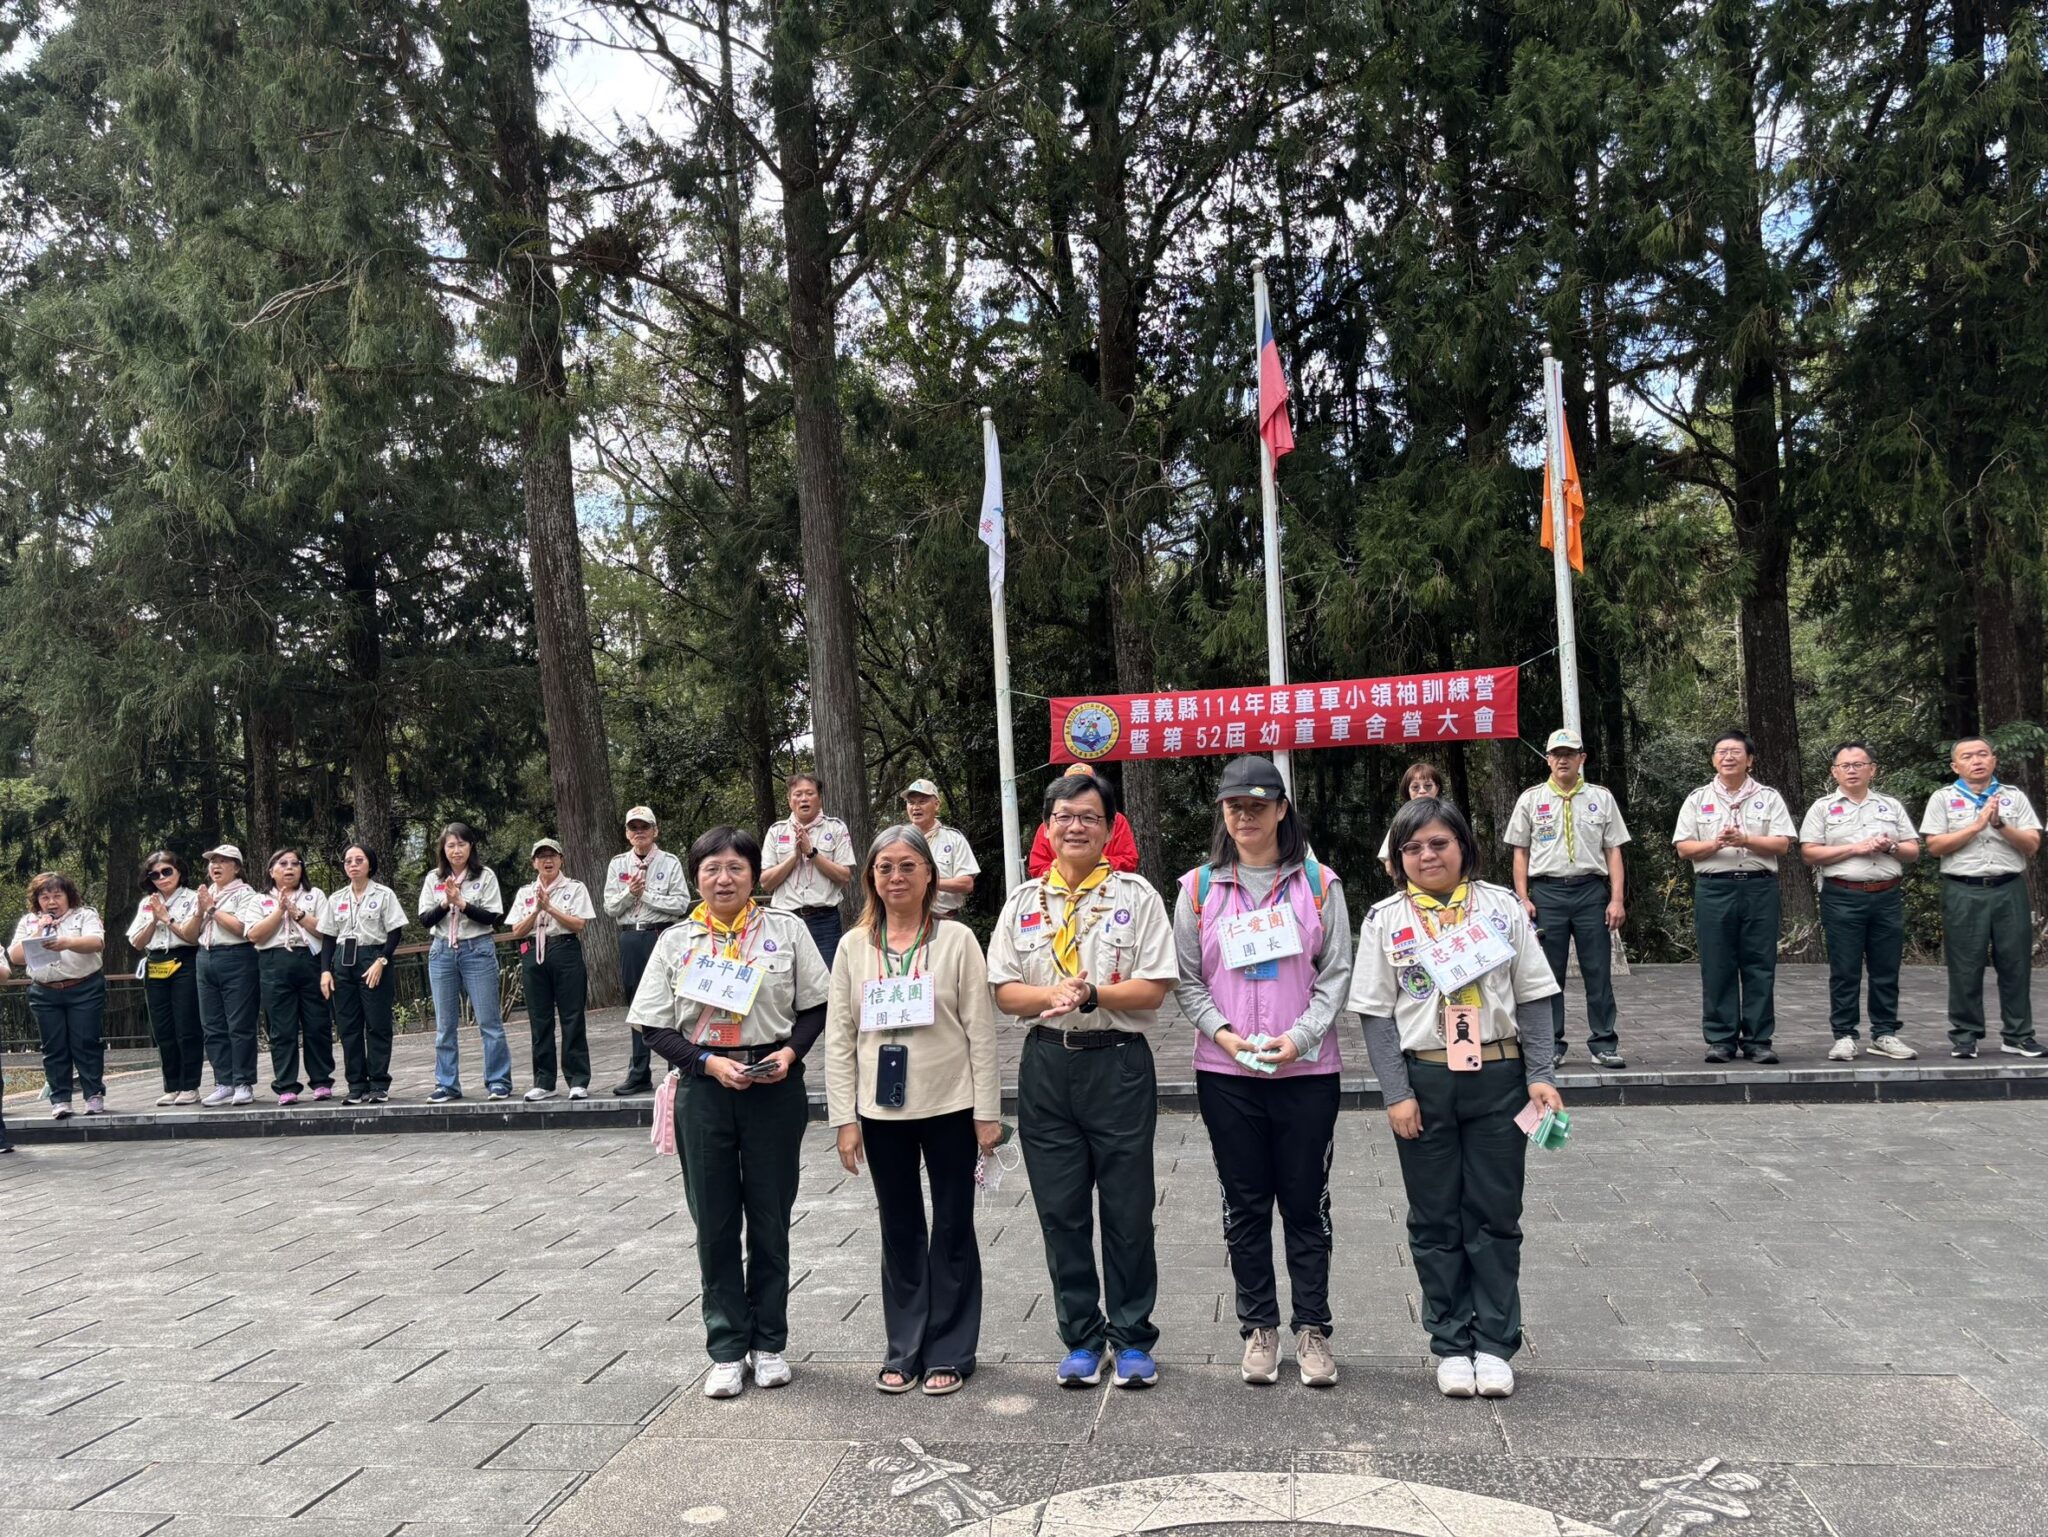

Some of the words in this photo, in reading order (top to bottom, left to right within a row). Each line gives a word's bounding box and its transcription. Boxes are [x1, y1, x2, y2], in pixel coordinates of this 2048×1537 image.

[1130, 674, 1495, 724] 嘉義縣114年度童軍小領袖訓練營
[1227, 911, 1284, 939] 仁愛團
[1243, 936, 1282, 957] 團長
[1430, 924, 1488, 966] 忠孝團
[696, 954, 754, 983] 和平團
[1450, 952, 1490, 980] 團長
[698, 978, 735, 999] 團長
[868, 983, 922, 1005] 信義團
[876, 1008, 911, 1025] 團長
